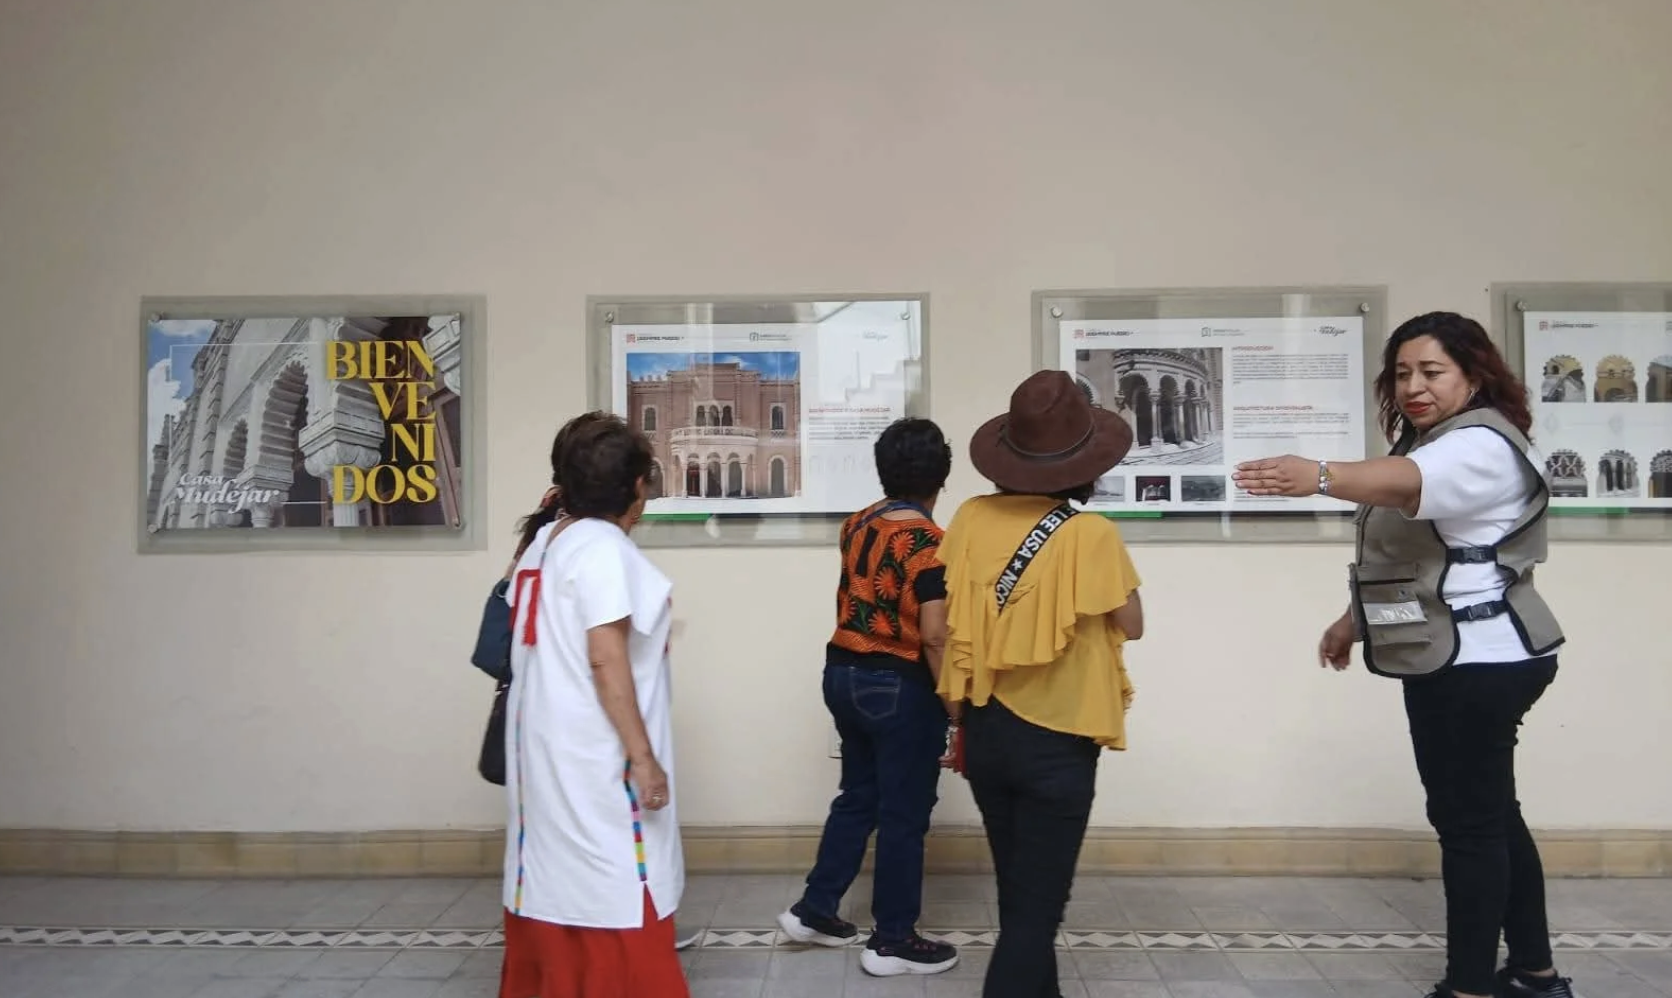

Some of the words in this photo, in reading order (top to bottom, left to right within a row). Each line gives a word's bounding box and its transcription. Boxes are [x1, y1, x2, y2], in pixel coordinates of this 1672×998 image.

[326, 340, 435, 380] BIEN
[368, 381, 437, 421] VE
[390, 422, 437, 462] NI
[332, 464, 437, 505] DOS
[1039, 509, 1068, 533] LEE
[1017, 529, 1048, 559] USA
[996, 569, 1018, 607] NICO
